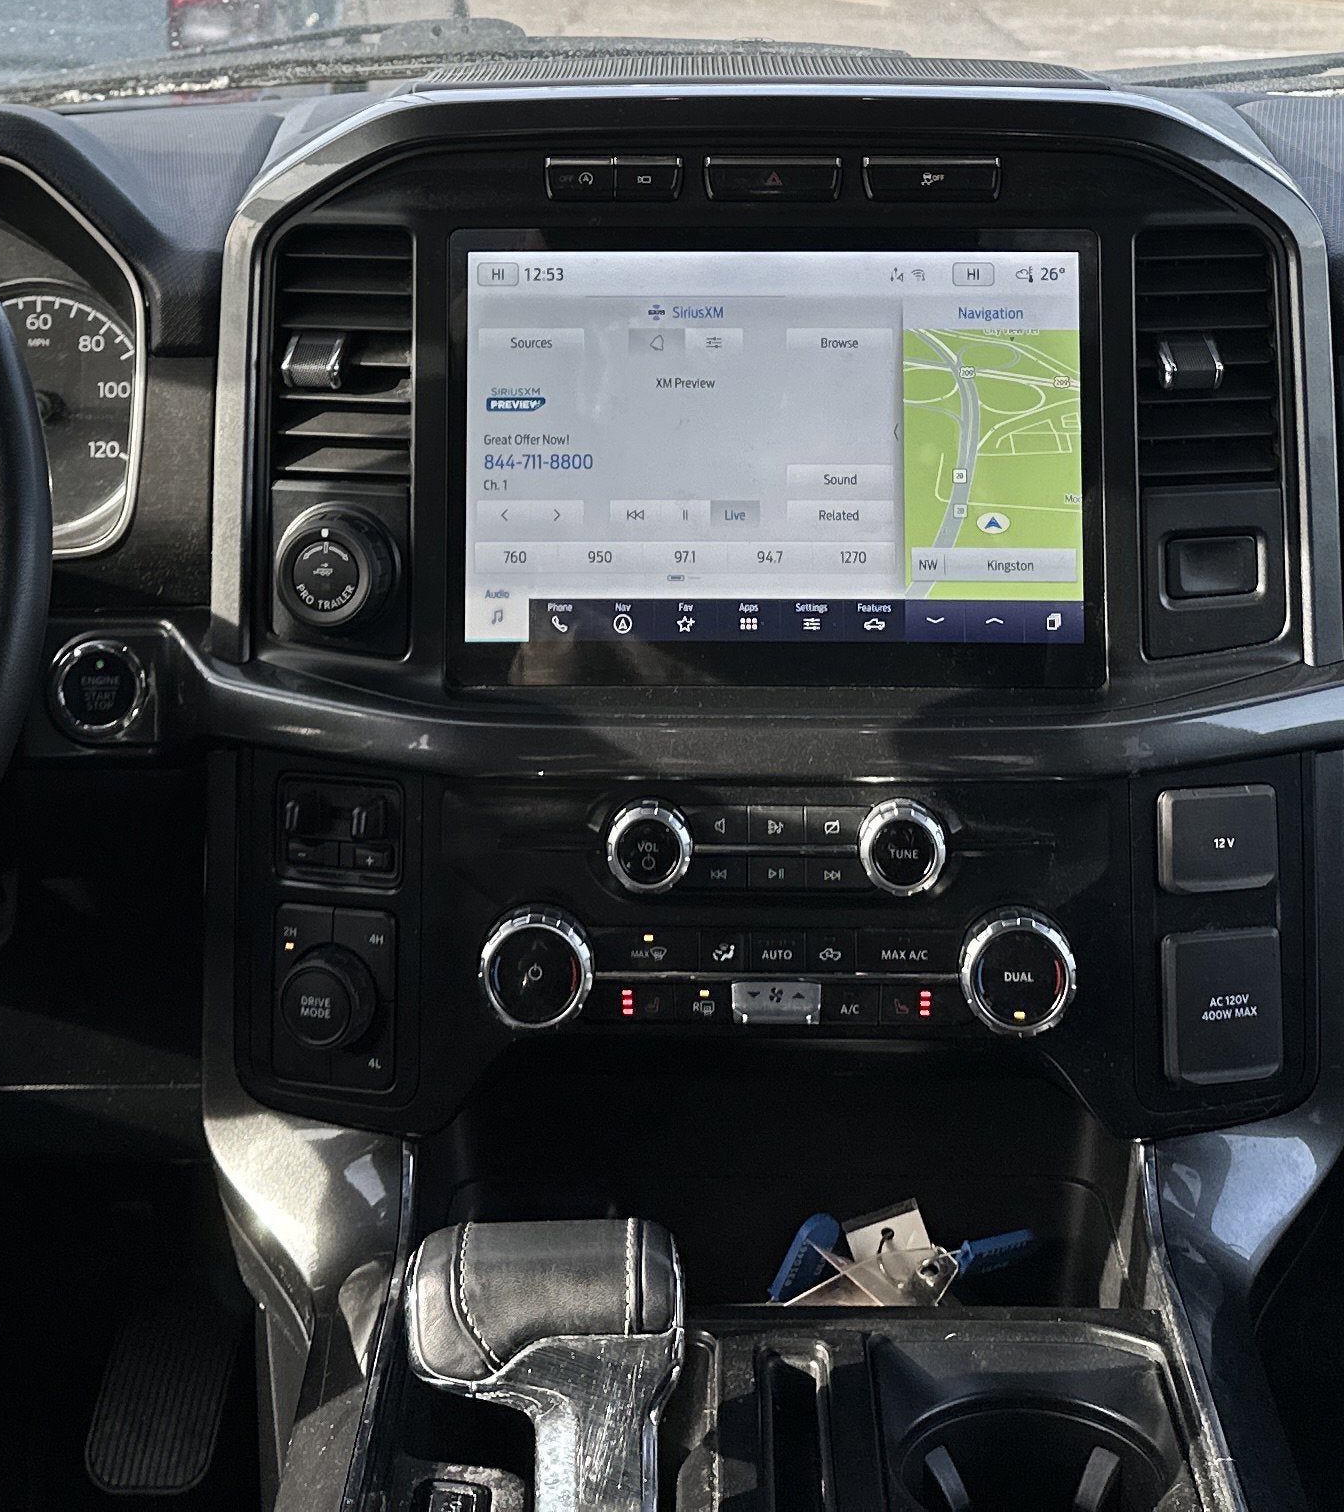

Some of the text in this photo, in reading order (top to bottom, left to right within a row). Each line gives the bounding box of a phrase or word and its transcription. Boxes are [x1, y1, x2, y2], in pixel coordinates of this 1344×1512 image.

[491, 268, 564, 281] HI 12:53
[967, 269, 980, 281] HI
[1040, 268, 1065, 280] 26°
[672, 307, 724, 320] SiriusXM
[958, 307, 1024, 322] Navigation
[26, 313, 52, 331] 60
[27, 338, 50, 348] MPH
[78, 335, 105, 352] 80
[510, 338, 553, 349] Sources
[821, 338, 858, 349] Browse
[656, 378, 715, 389] XM Preview
[97, 381, 131, 399] 100
[491, 399, 538, 410] PREVIEW
[483, 435, 569, 446] Great Offer Now!
[88, 440, 120, 459] 120
[484, 454, 593, 470] 844-711-8800
[483, 480, 508, 491] Ch. 1
[824, 474, 858, 486] Sound
[725, 510, 746, 521] Live
[819, 510, 859, 521] Related
[504, 551, 527, 564] 760
[588, 551, 612, 564] 950
[674, 551, 696, 564] 97.1
[757, 551, 783, 564] 94.7
[840, 551, 866, 564] 1270
[919, 561, 938, 571] NW
[987, 560, 1034, 573] Kingston
[296, 583, 355, 610] PRO TRAILER
[485, 590, 510, 599] Audio
[548, 603, 573, 612] Phone
[615, 603, 631, 612] Nav
[678, 603, 693, 612] Fav
[739, 603, 758, 613] Apps
[795, 603, 828, 613] Settings
[857, 603, 891, 612] Features
[81, 675, 120, 687] ENGINE
[84, 691, 117, 701] START
[86, 700, 115, 711] STOP
[637, 842, 659, 854] VOL
[889, 848, 919, 860] TUNE
[283, 926, 297, 937] 2H
[368, 934, 384, 945] 4H
[630, 949, 648, 960] MAX
[761, 950, 792, 961] AUTO
[881, 949, 929, 962] MAX A/C
[1003, 971, 1034, 983] DUAL
[301, 996, 331, 1008] DRIVE
[1210, 994, 1250, 1008] AC 120V
[300, 1007, 331, 1019] MODE
[839, 1003, 860, 1016] A/C
[1202, 1006, 1258, 1021] 400W MAX
[367, 1058, 382, 1070] 4L
